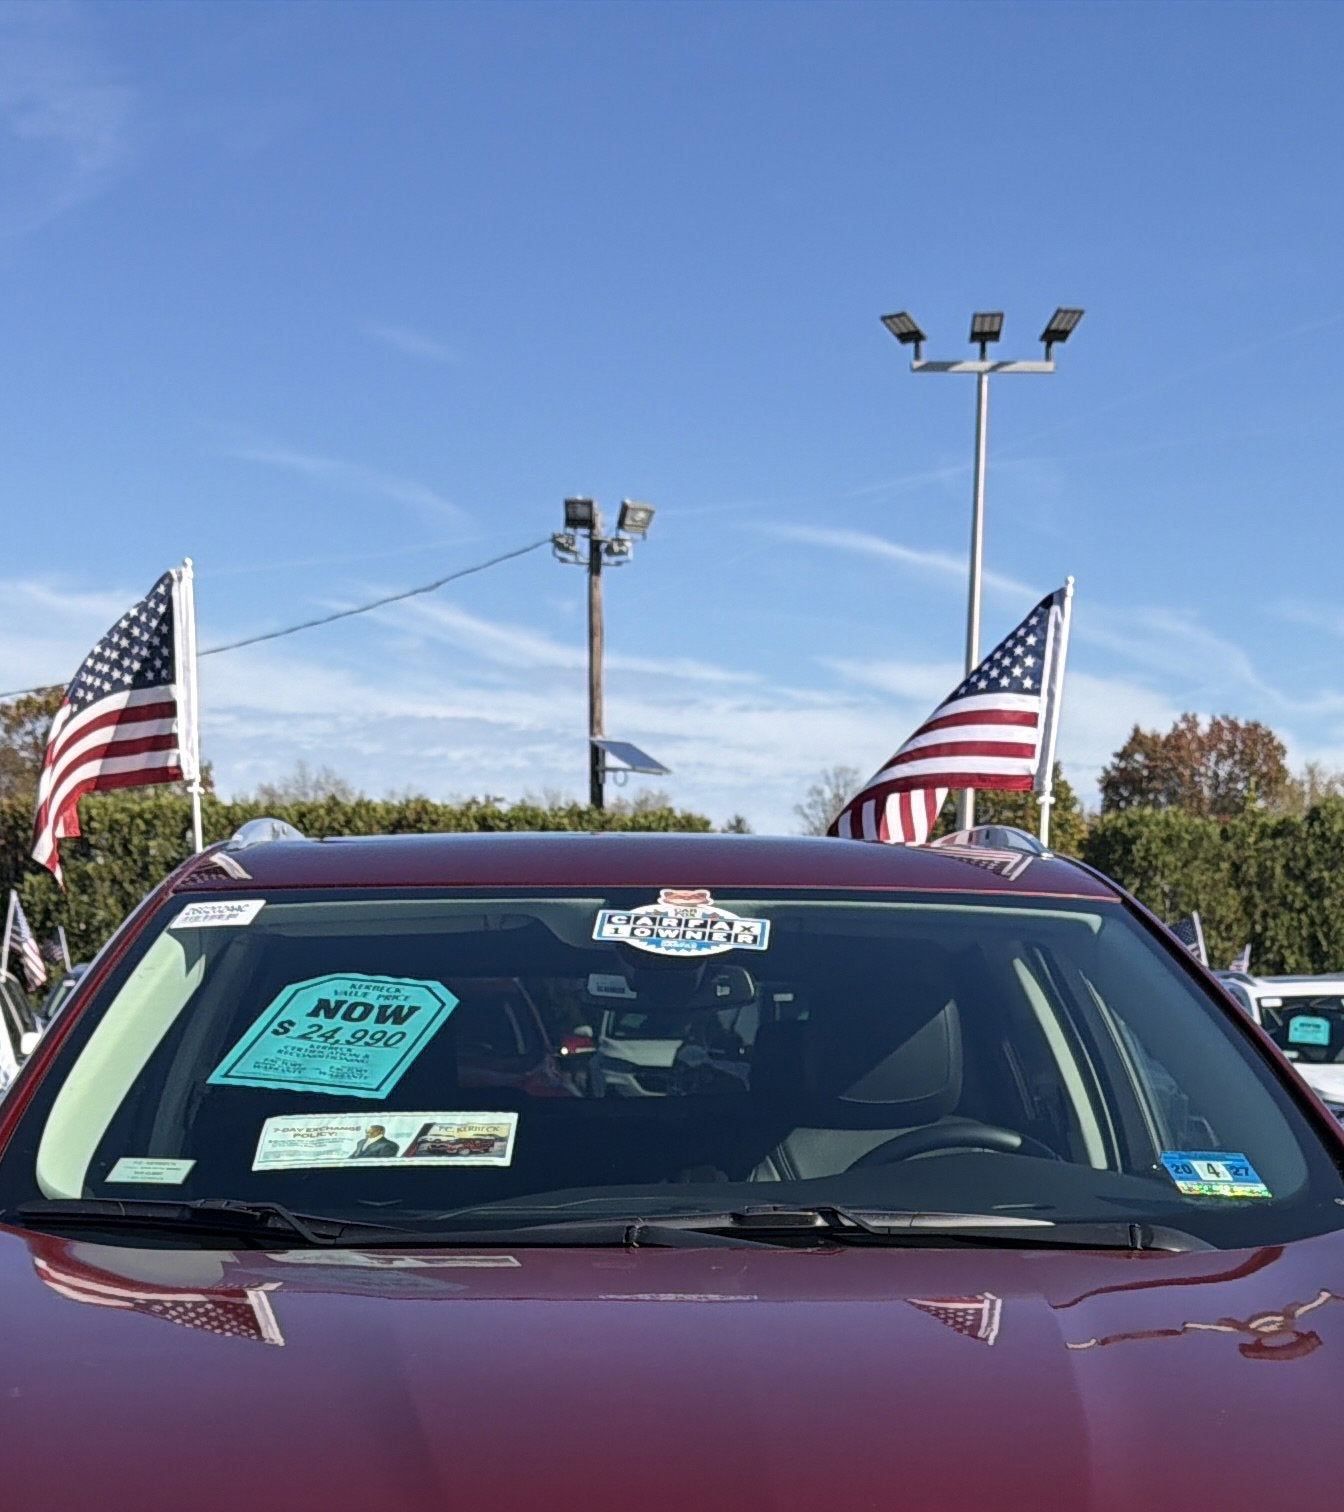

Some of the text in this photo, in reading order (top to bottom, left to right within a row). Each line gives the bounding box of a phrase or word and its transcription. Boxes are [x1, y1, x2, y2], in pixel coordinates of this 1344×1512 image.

[610, 914, 756, 933] CARFAX
[633, 928, 756, 944] OWNER
[305, 998, 422, 1026] NOW
[1206, 1163, 1221, 1178] 4
